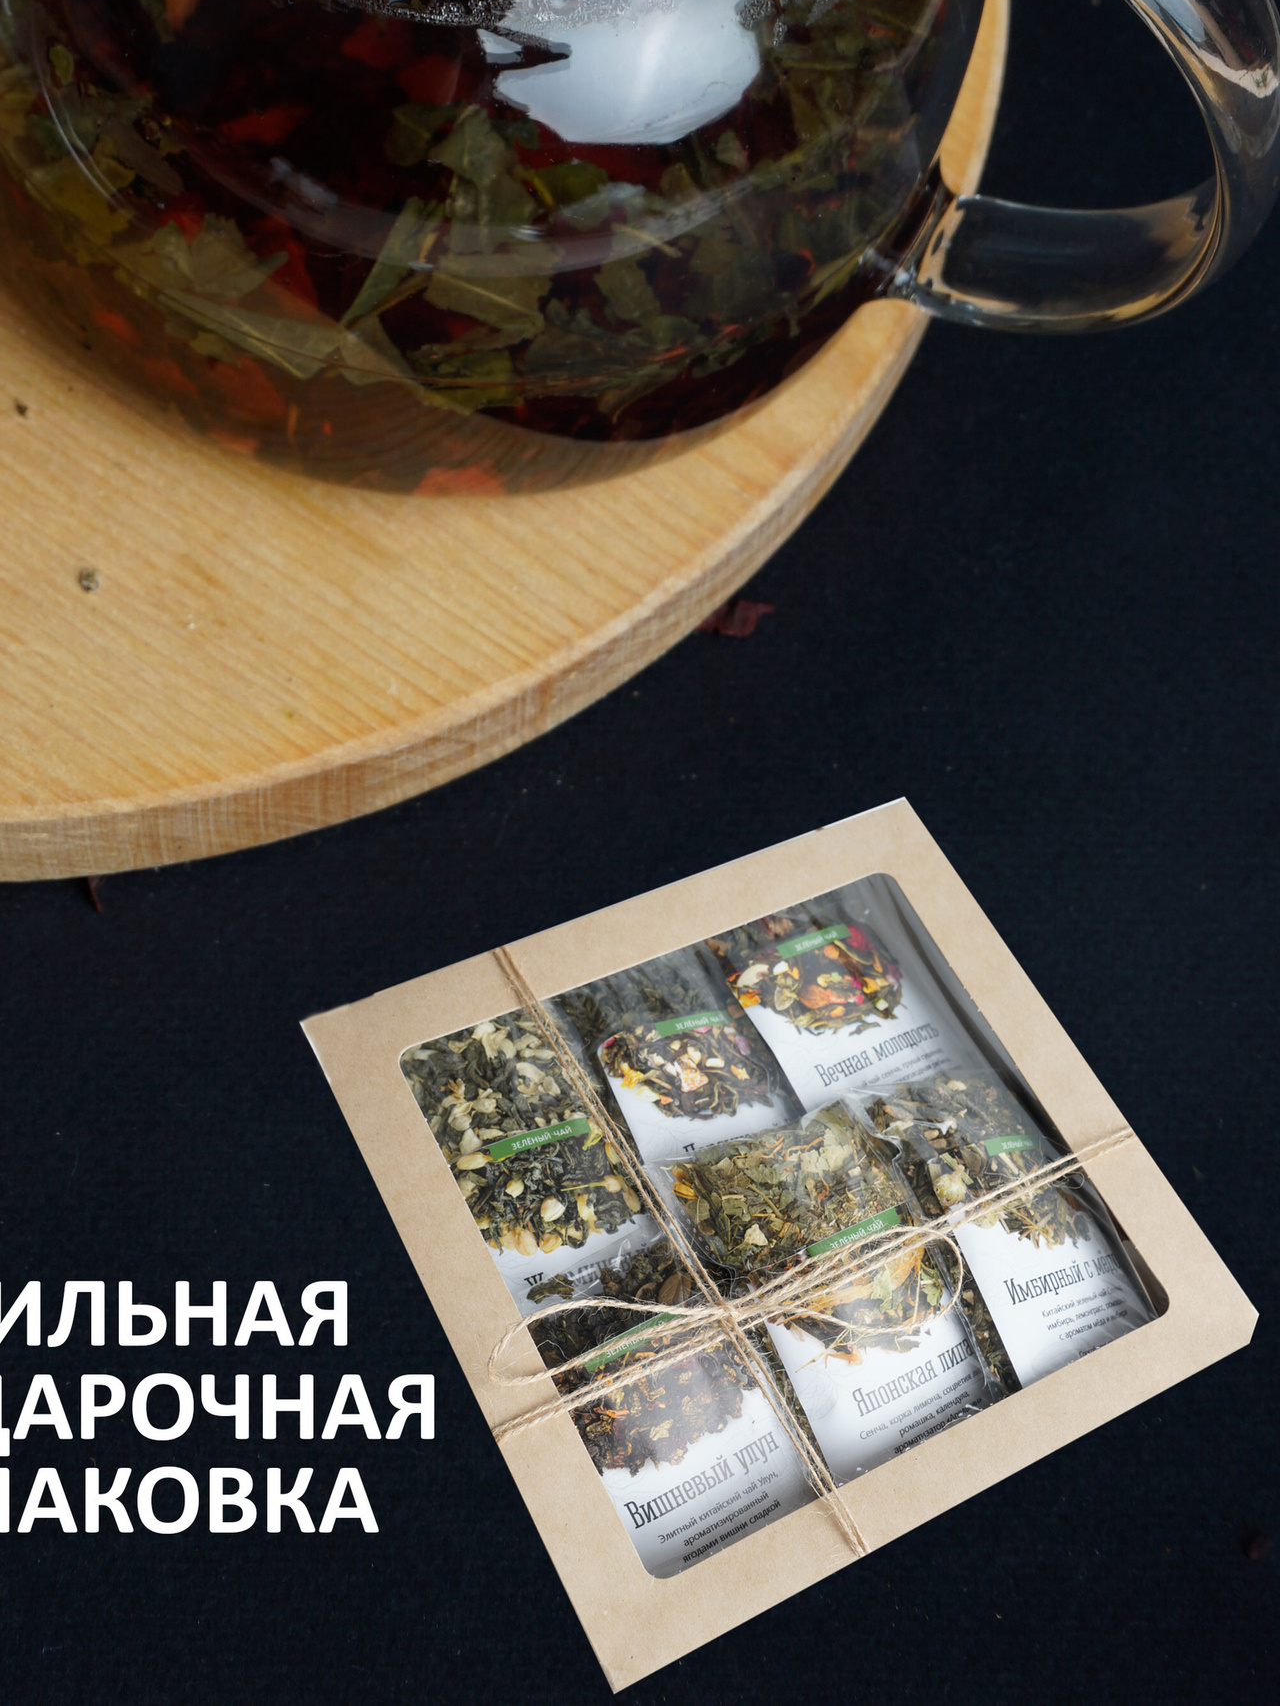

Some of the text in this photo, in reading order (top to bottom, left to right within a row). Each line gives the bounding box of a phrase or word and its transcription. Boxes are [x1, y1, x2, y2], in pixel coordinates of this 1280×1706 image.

[674, 1015, 709, 1031] ЗЕЛЁНЫЙ
[813, 1023, 939, 1087] Вечная молодость
[511, 1126, 572, 1151] ЗЕЛЁНЫЙ ЧАЙ
[866, 1219, 885, 1232] ЧАЙ
[1003, 1260, 1087, 1305] Имбирный
[1084, 1261, 1094, 1279] с
[1041, 1299, 1076, 1319] Китайский
[1046, 1317, 1076, 1332] имбирь,
[1064, 1323, 1093, 1339] ароматом
[852, 1337, 975, 1417] Японская липа
[859, 1422, 888, 1441] Сенча,
[888, 1408, 913, 1428] корка
[913, 1393, 943, 1414] лимона,
[942, 1374, 972, 1396] соцветия
[898, 1390, 971, 1438] ромашка, календула,
[894, 1421, 946, 1455] ароматизатор
[624, 1431, 779, 1529] Вишневый улун
[657, 1471, 779, 1544] Элитный китайский чай Улун,
[683, 1491, 769, 1547] ароматизированный
[682, 1500, 782, 1564] ягодами вишни сладкой
